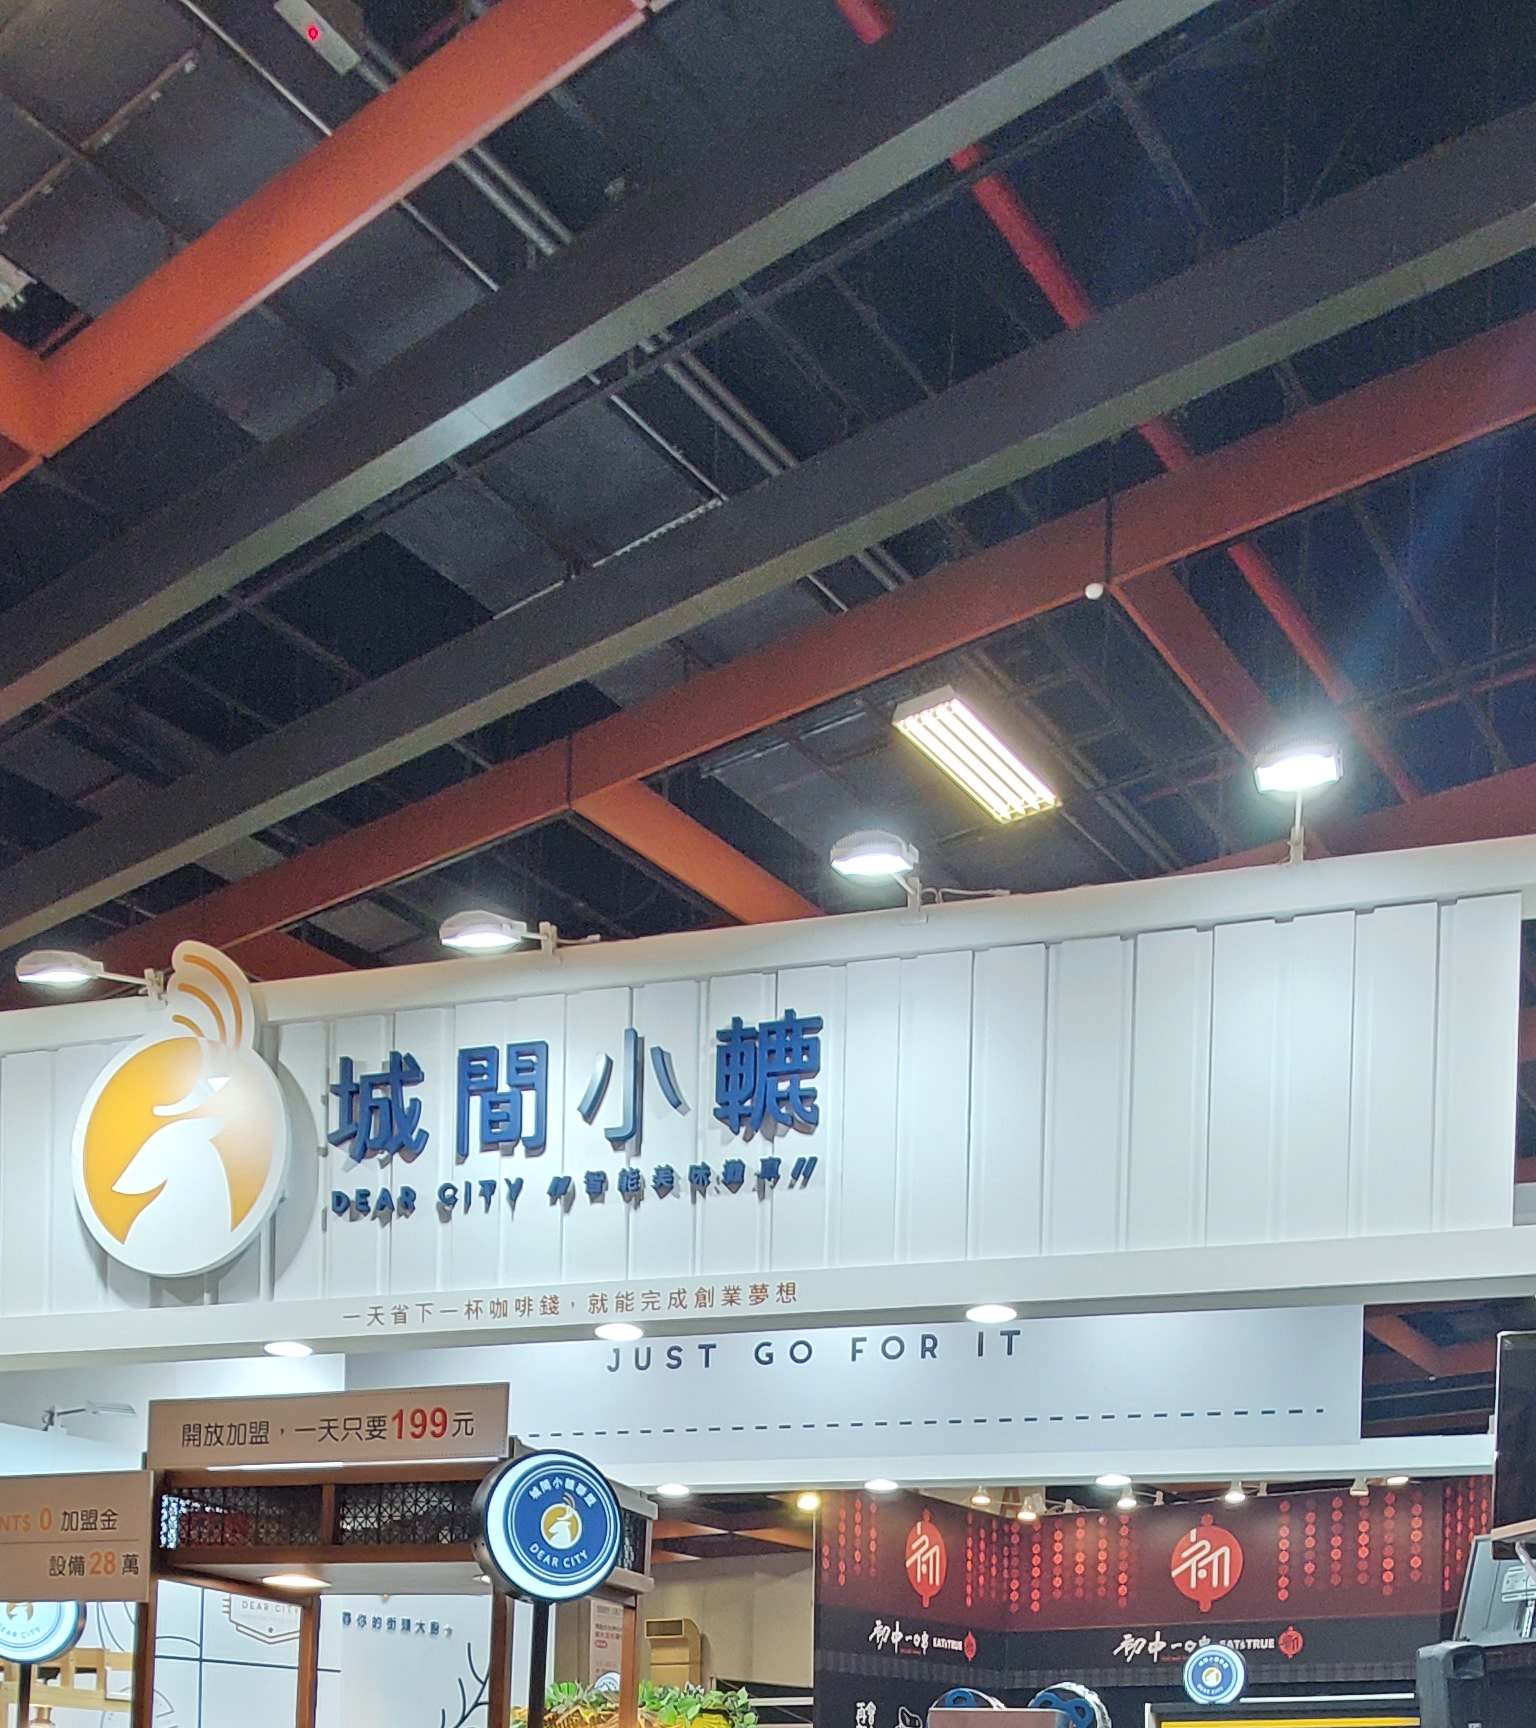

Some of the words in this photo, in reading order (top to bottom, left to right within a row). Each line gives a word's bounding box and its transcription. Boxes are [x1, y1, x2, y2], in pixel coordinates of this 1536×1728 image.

[327, 1009, 824, 1164] 城間小轆
[331, 1185, 417, 1215] DEAR
[437, 1176, 524, 1215] CITY
[606, 1343, 718, 1373] JUST
[754, 1339, 814, 1366] GO
[850, 1333, 939, 1363] FOR
[977, 1329, 1022, 1357] IT
[38, 1506, 54, 1532] 0
[59, 1508, 119, 1533] 加盟金
[528, 1543, 559, 1569] DEAR
[562, 1549, 589, 1569] CITY
